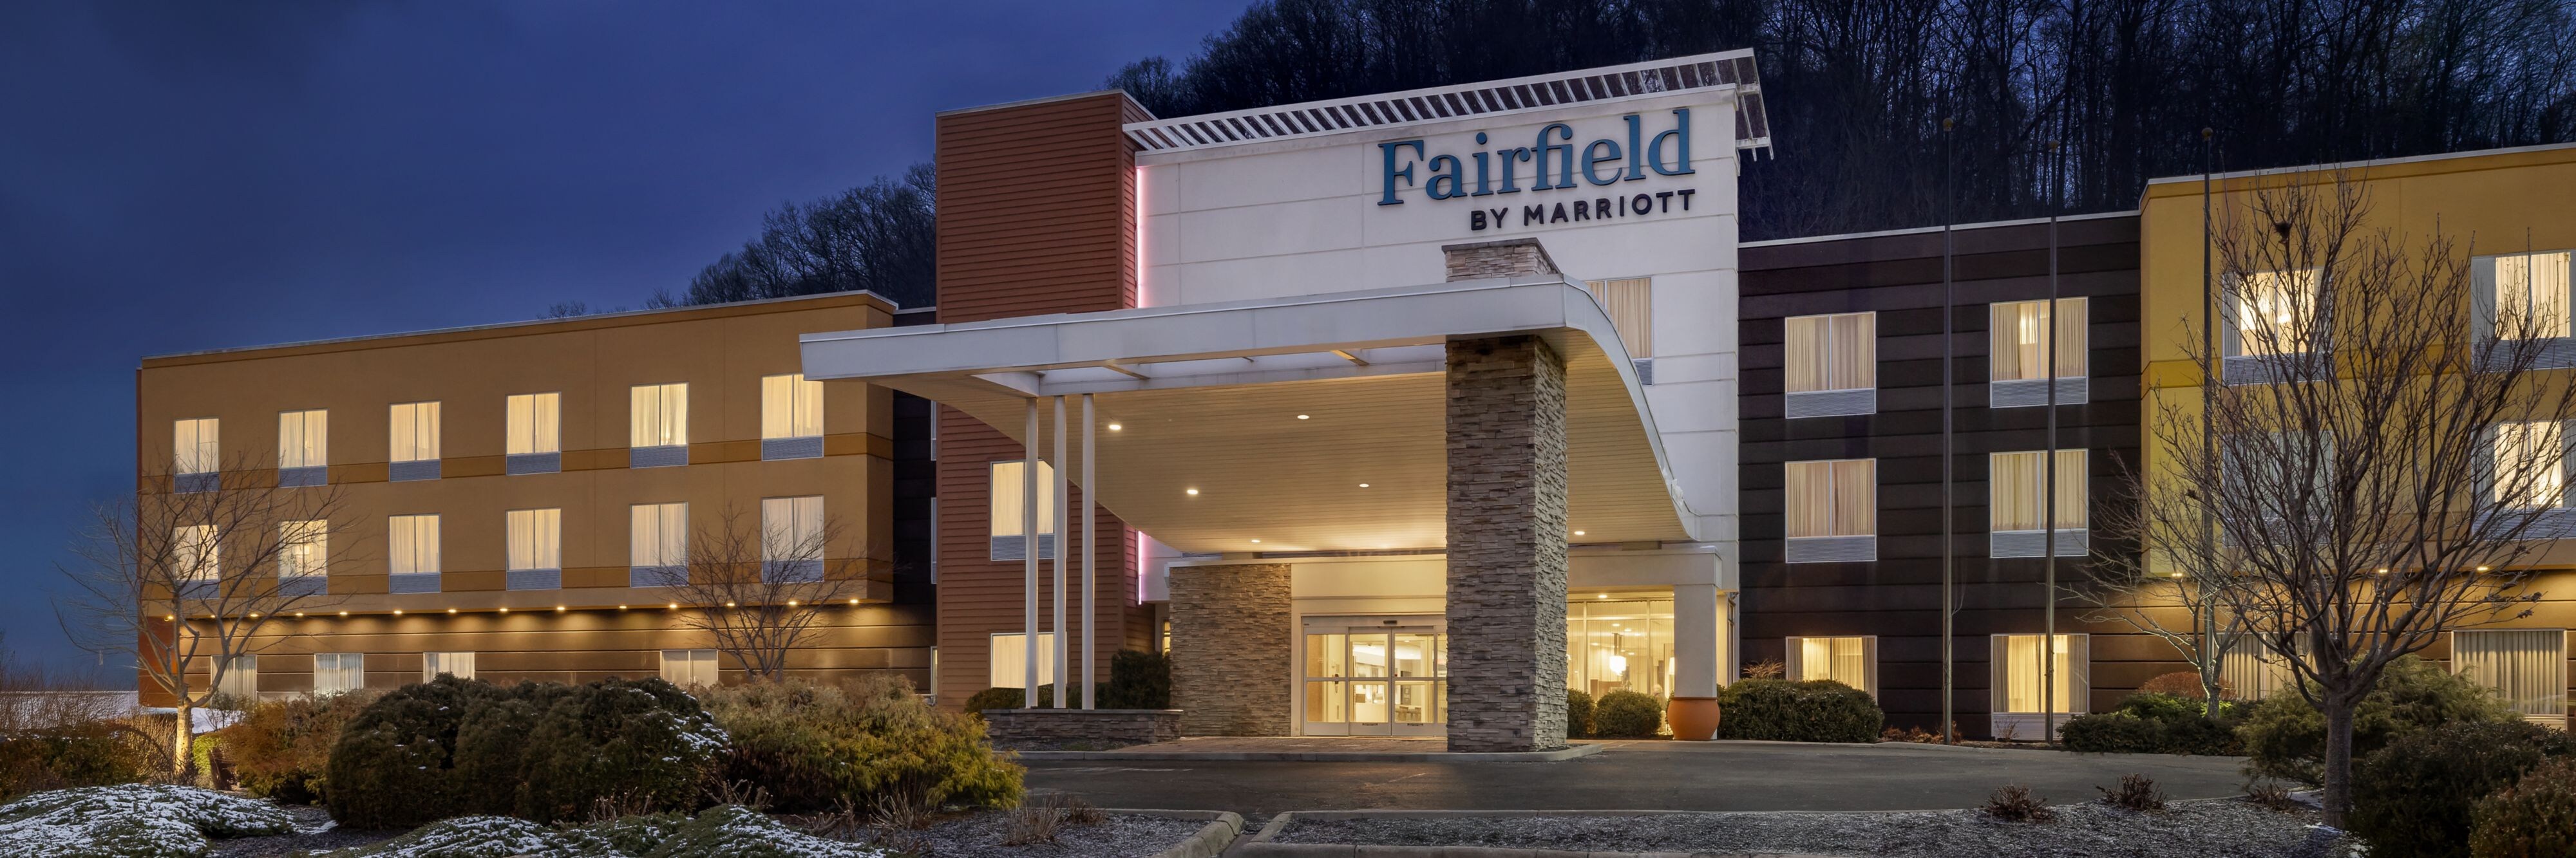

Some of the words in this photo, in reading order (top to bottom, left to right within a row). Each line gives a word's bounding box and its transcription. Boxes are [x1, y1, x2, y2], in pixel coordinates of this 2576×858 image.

[1377, 108, 1696, 206] Fairfield
[1470, 207, 1508, 230] BY
[1524, 189, 1696, 227] MARRIOTT
